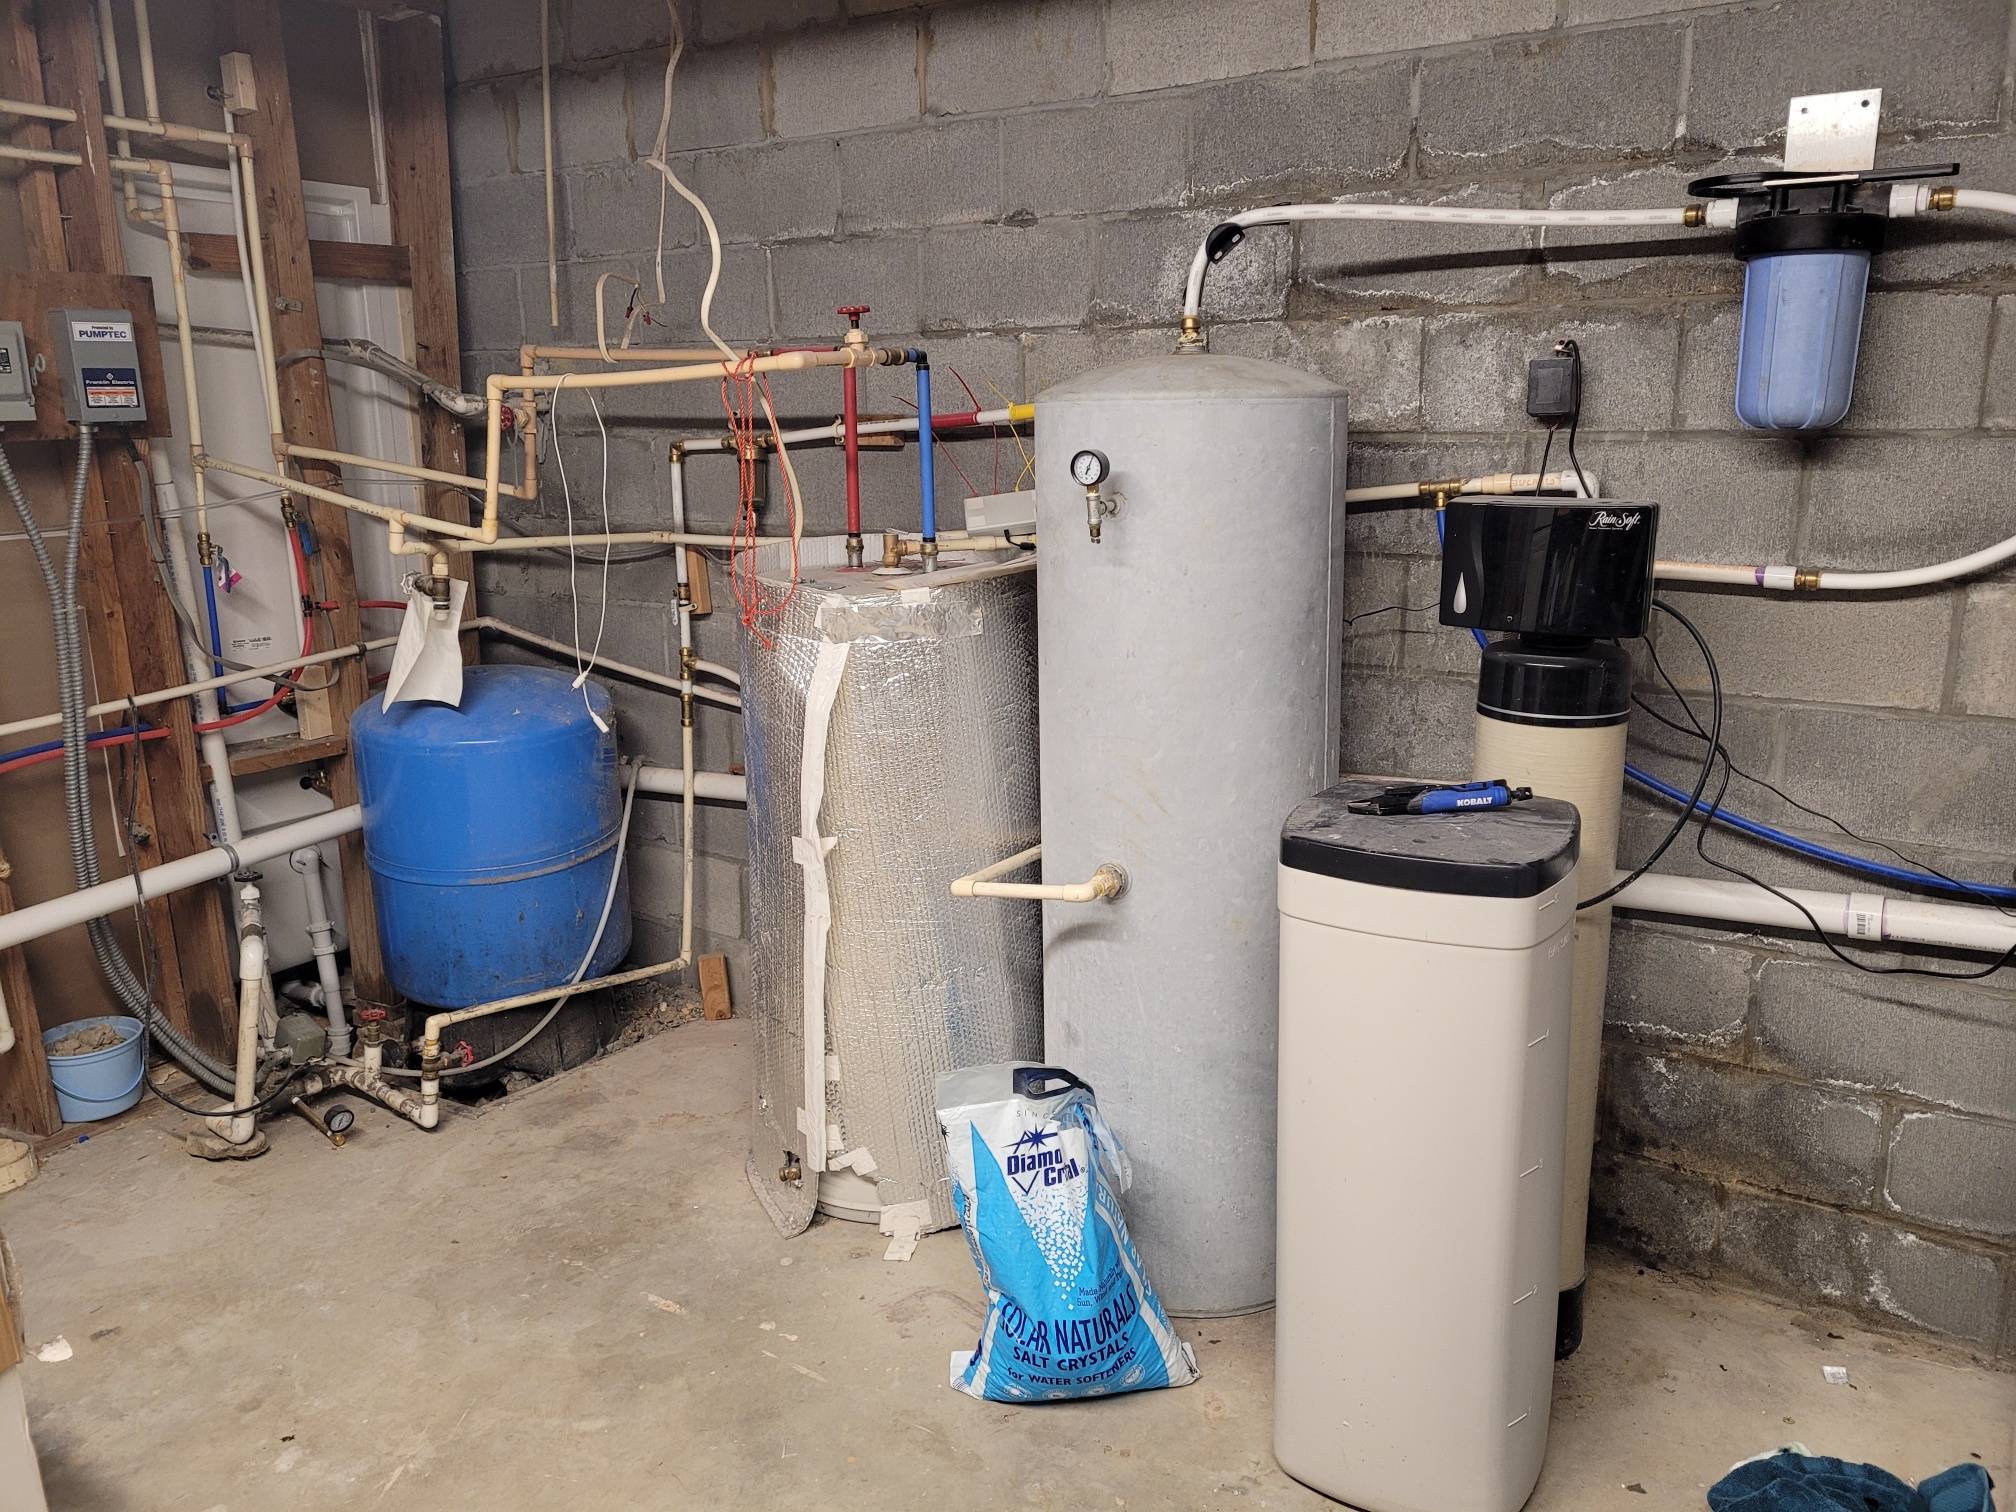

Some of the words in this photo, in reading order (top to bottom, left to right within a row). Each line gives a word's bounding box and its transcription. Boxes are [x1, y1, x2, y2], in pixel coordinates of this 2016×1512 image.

[78, 330, 127, 339] PUMPTEC
[1457, 797, 1493, 807] KOBALT
[1007, 1148, 1063, 1177] Diamo
[1078, 1286, 1099, 1297] Made
[1076, 1297, 1093, 1308] Sun,
[1000, 1301, 1052, 1355] SOLAR
[1054, 1283, 1137, 1355] NATURALS
[1013, 1345, 1050, 1369] SALT
[1057, 1331, 1129, 1371] CRYSTALS
[1007, 1366, 1025, 1381] for
[1029, 1374, 1072, 1386] WATER
[1076, 1346, 1137, 1384] SOFTENERS
